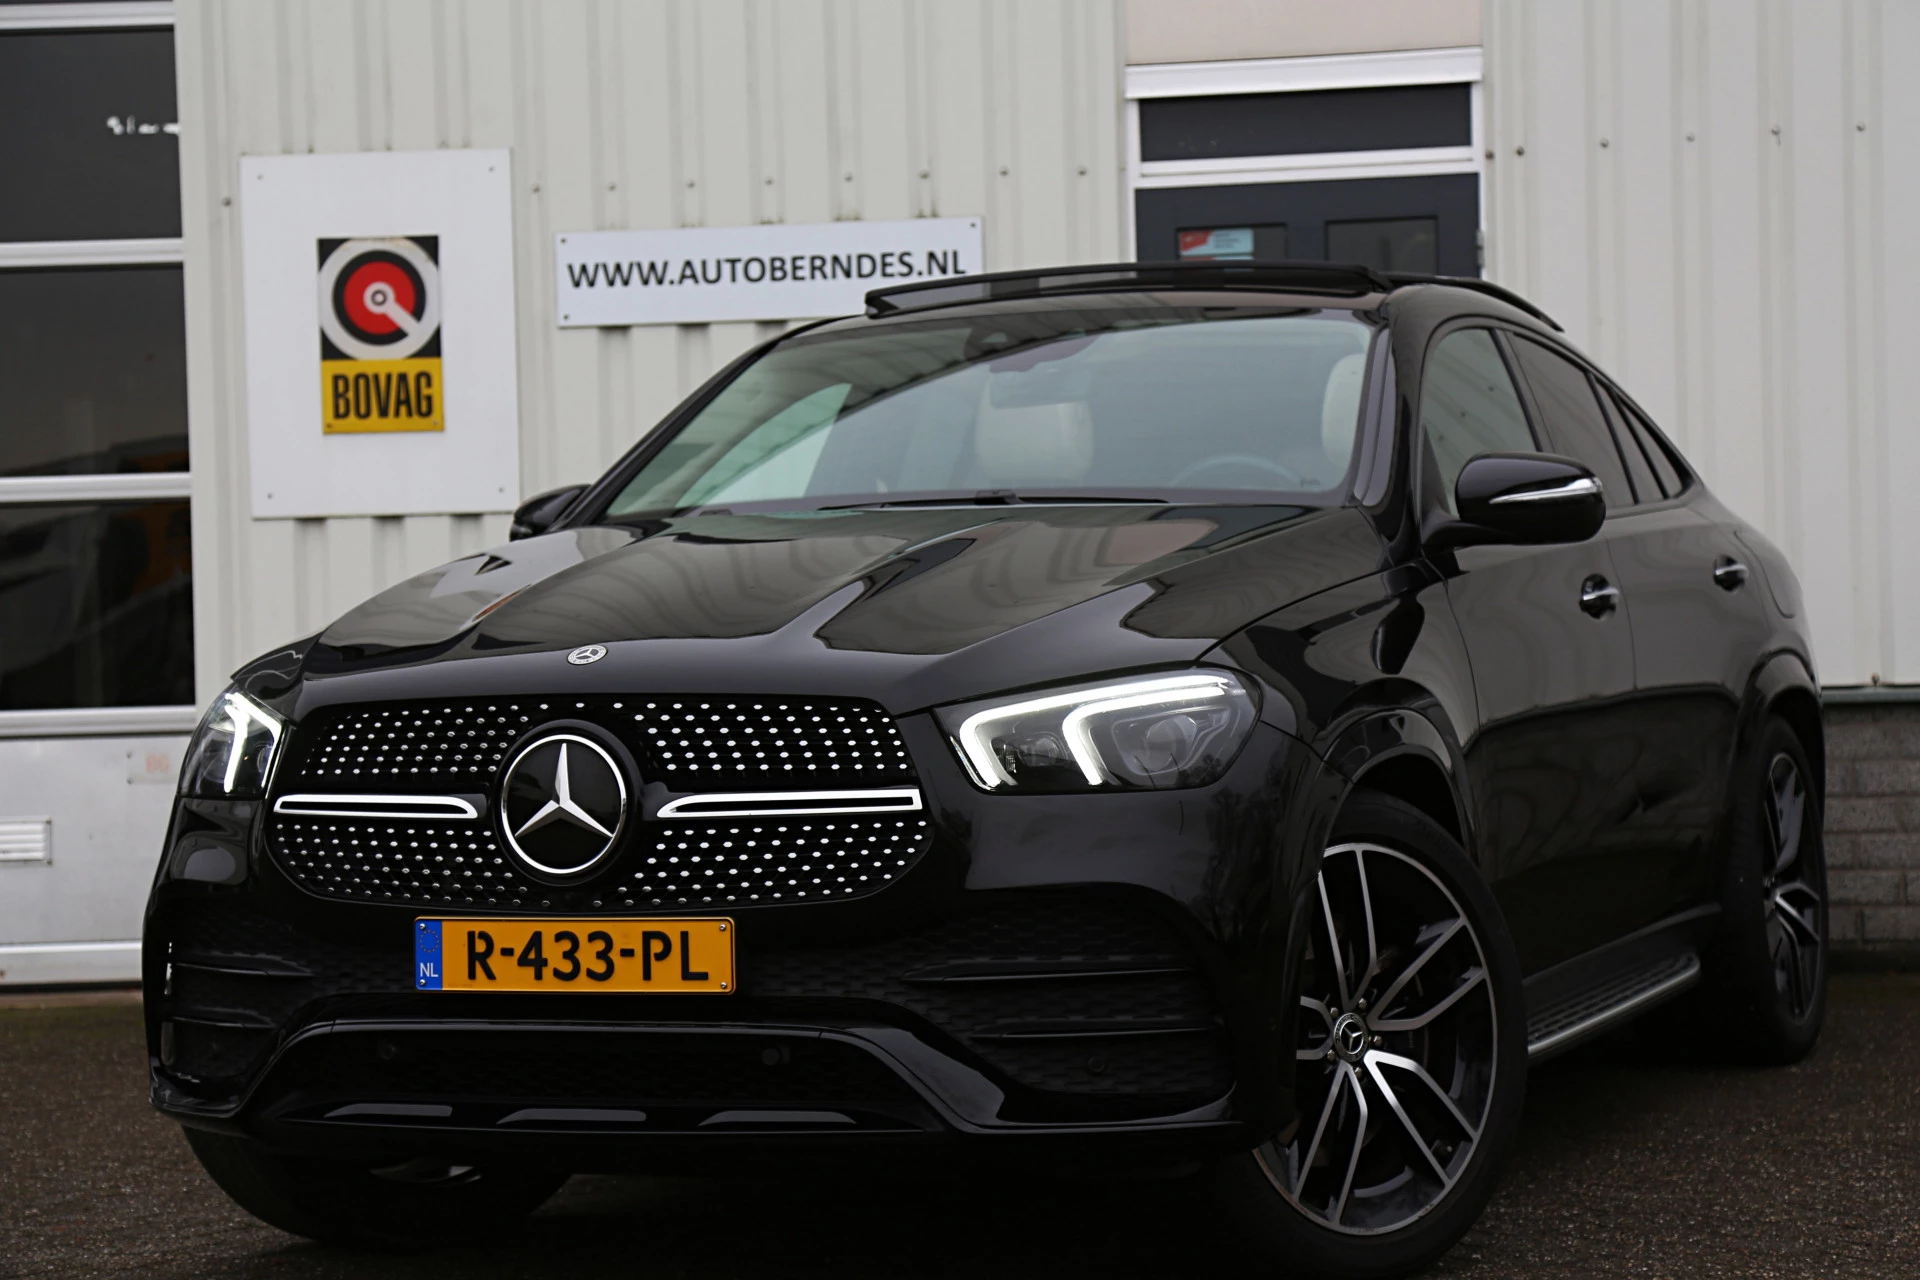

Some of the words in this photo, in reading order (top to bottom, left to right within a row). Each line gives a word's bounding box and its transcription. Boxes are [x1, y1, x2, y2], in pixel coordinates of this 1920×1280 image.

[567, 250, 967, 288] WWW.AUTOBERNDES.NL
[332, 370, 434, 420] BOVAG
[420, 962, 439, 978] NL
[467, 930, 709, 981] R-433-PL
